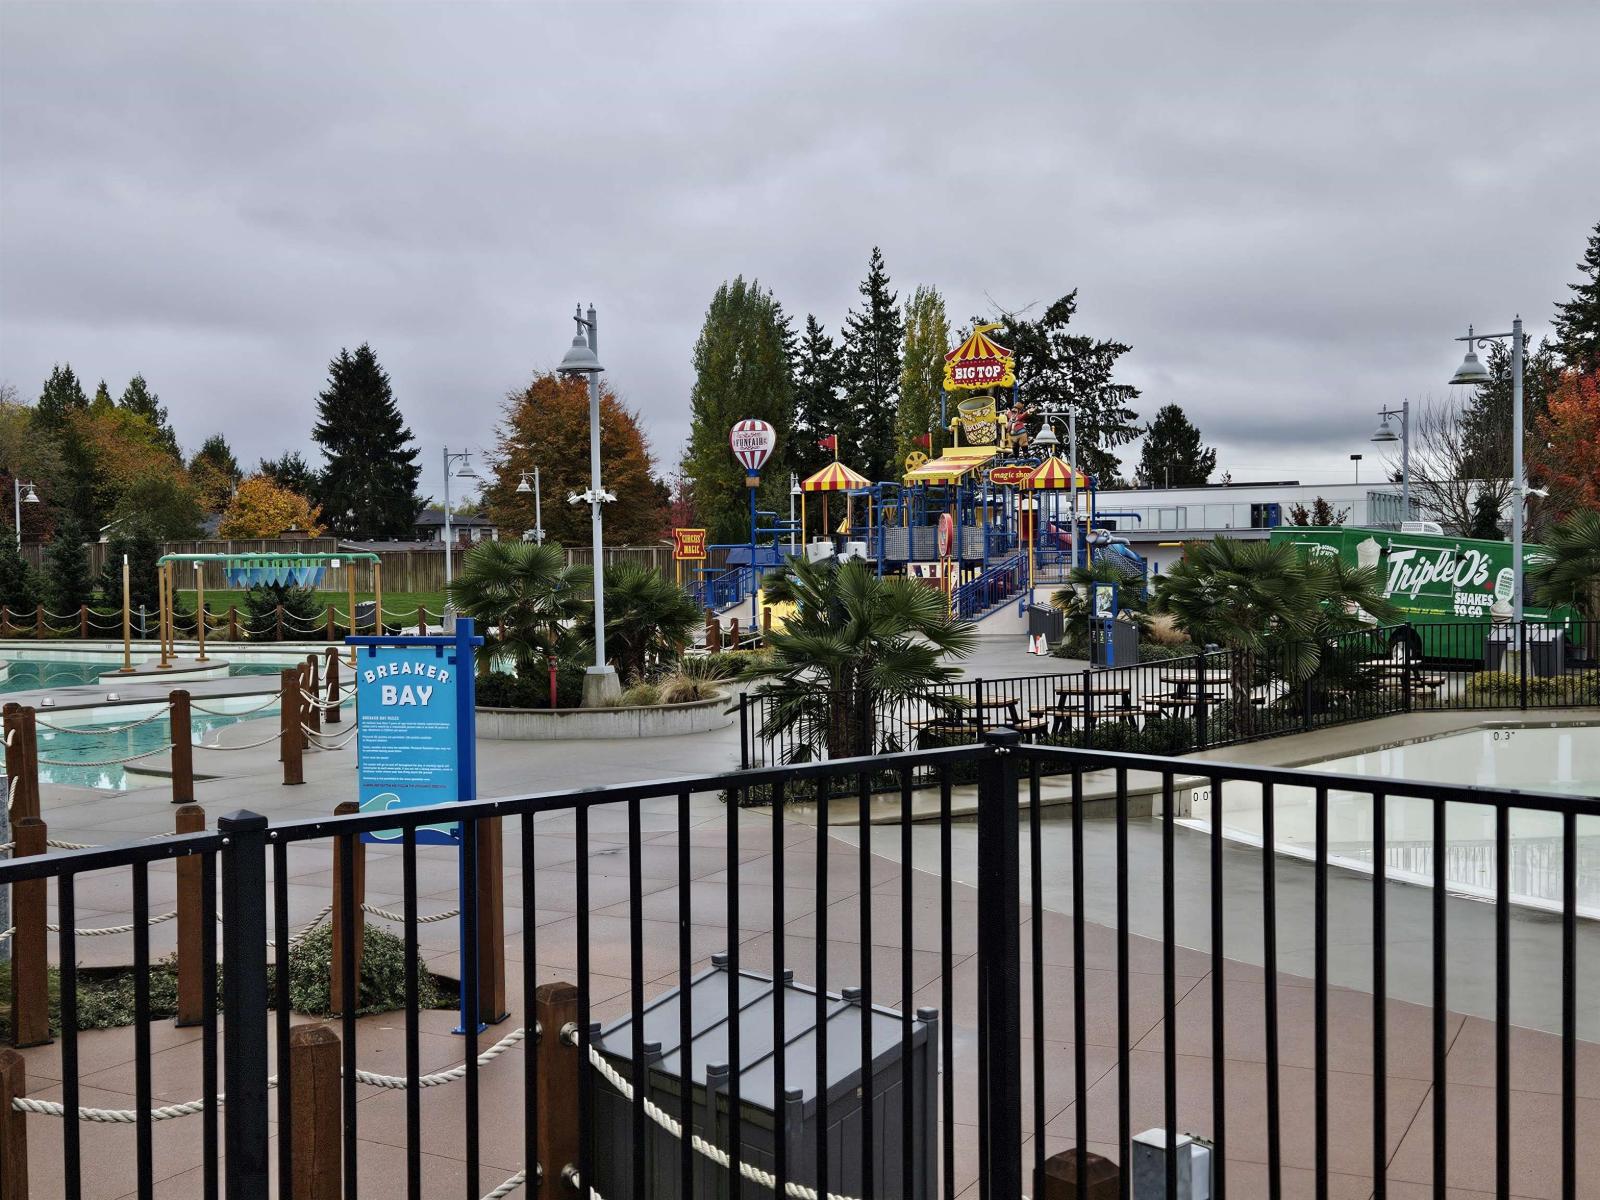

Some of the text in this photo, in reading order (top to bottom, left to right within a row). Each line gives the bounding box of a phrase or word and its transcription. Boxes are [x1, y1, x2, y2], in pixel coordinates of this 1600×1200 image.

[955, 365, 1001, 380] BIG TOP
[993, 471, 1014, 481] magic
[683, 545, 700, 554] MAGIC
[1382, 549, 1457, 600] Triple
[1454, 592, 1494, 607] SHAKES
[1453, 604, 1467, 617] TO
[1468, 605, 1483, 618] GO
[364, 661, 450, 684] BREAKER
[381, 684, 433, 706] BAY
